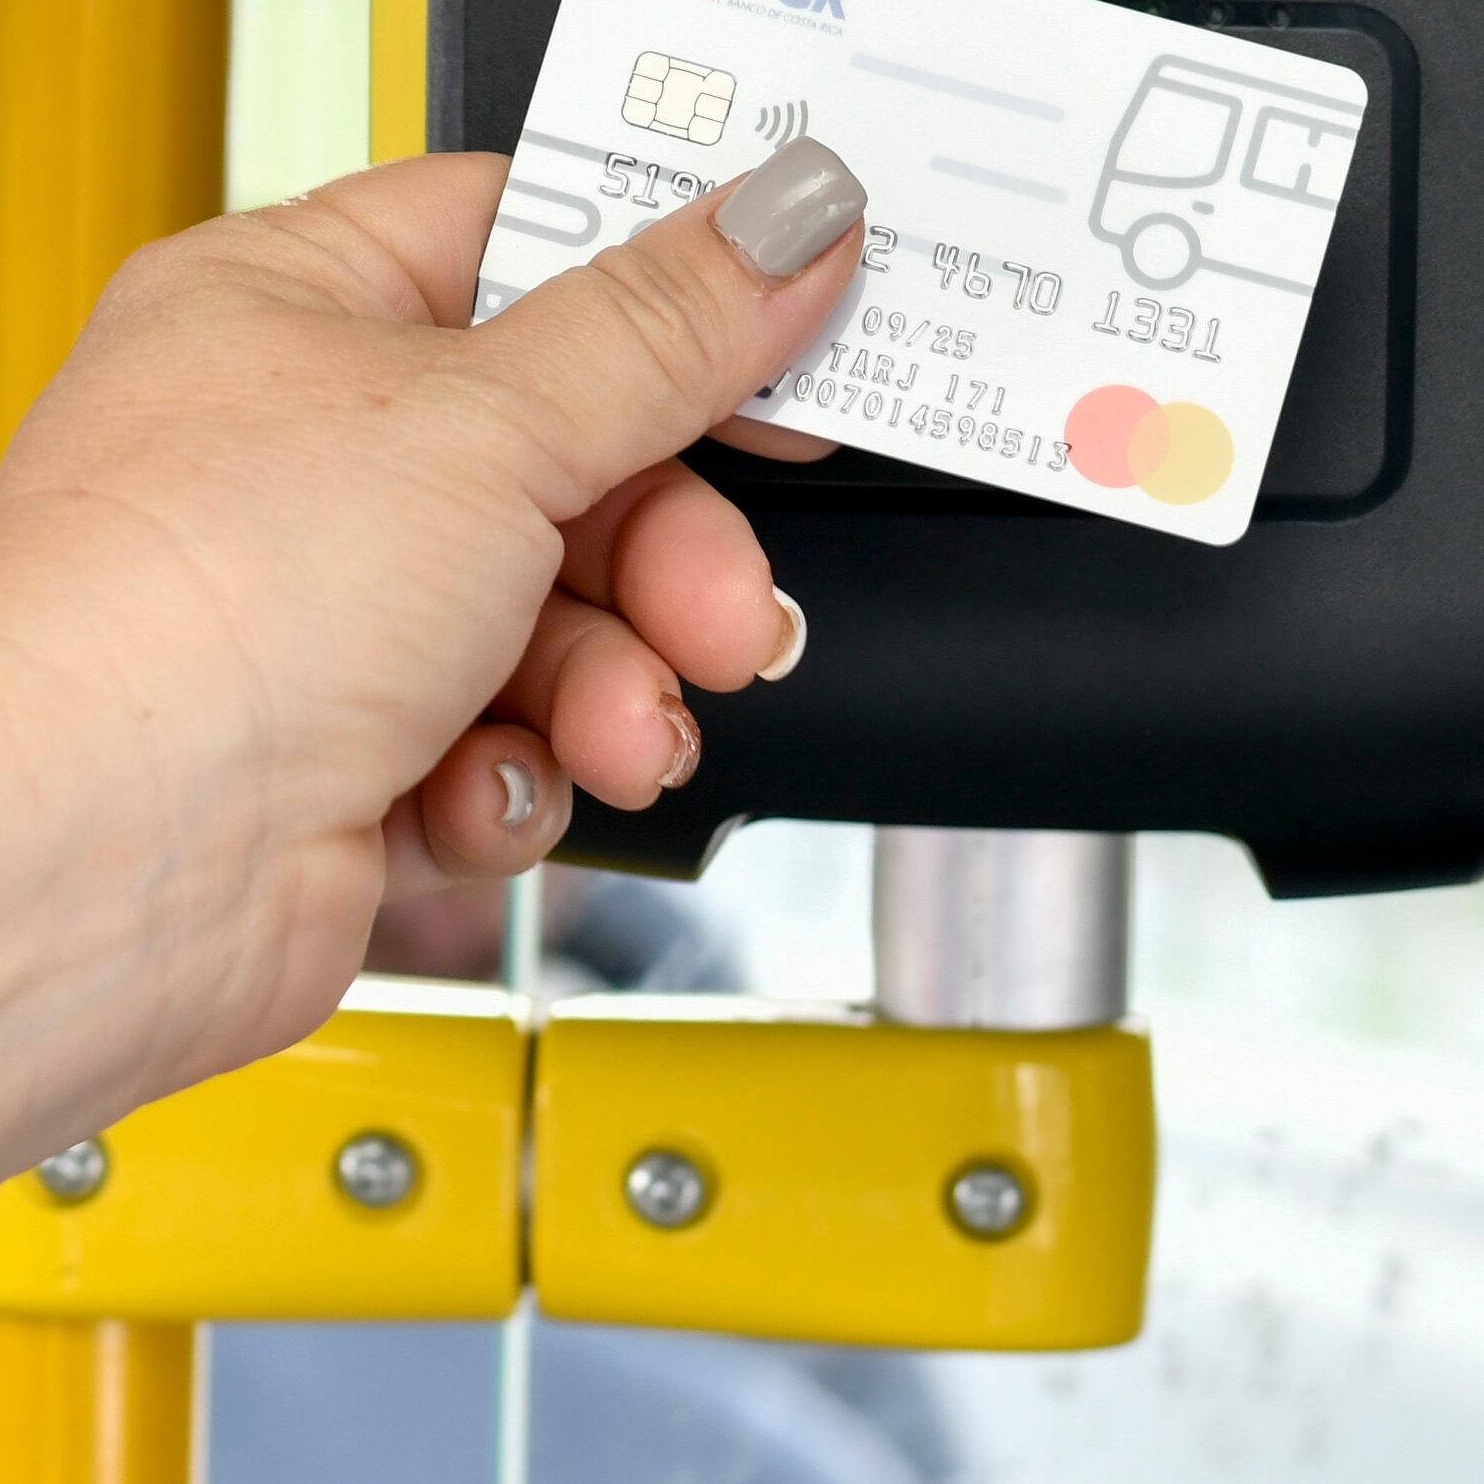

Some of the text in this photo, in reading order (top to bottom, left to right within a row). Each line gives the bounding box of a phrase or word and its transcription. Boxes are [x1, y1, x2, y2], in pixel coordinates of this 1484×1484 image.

[767, 7, 782, 21] DE
[783, 12, 817, 30] COSTA
[819, 22, 844, 36] RICA
[932, 242, 1063, 317] 4670
[1091, 290, 1222, 364] 1331
[862, 306, 977, 360] 09/25
[828, 342, 918, 392] TARJ
